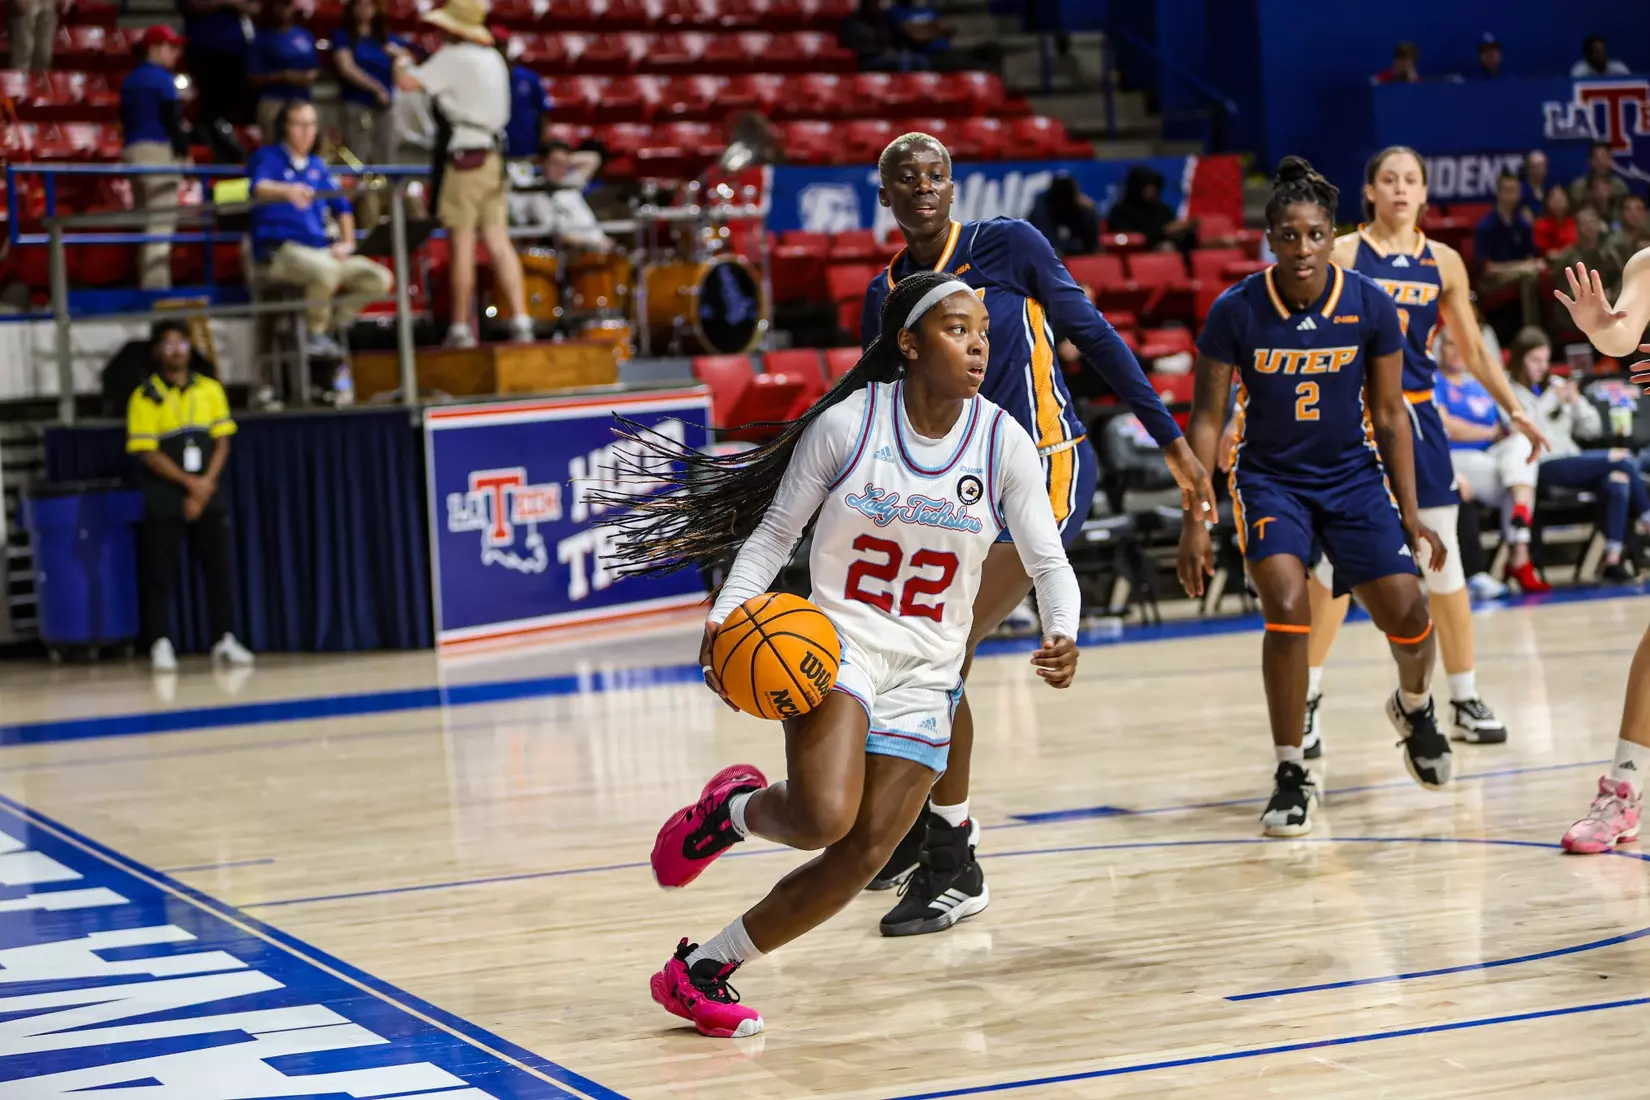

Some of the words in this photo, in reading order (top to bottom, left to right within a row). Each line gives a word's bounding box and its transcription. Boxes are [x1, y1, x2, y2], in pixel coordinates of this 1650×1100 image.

[1254, 346, 1359, 375] UTEP
[1295, 381, 1320, 421] 2
[845, 482, 900, 527] Lady
[899, 494, 983, 534] Techsters
[844, 533, 960, 623] 22
